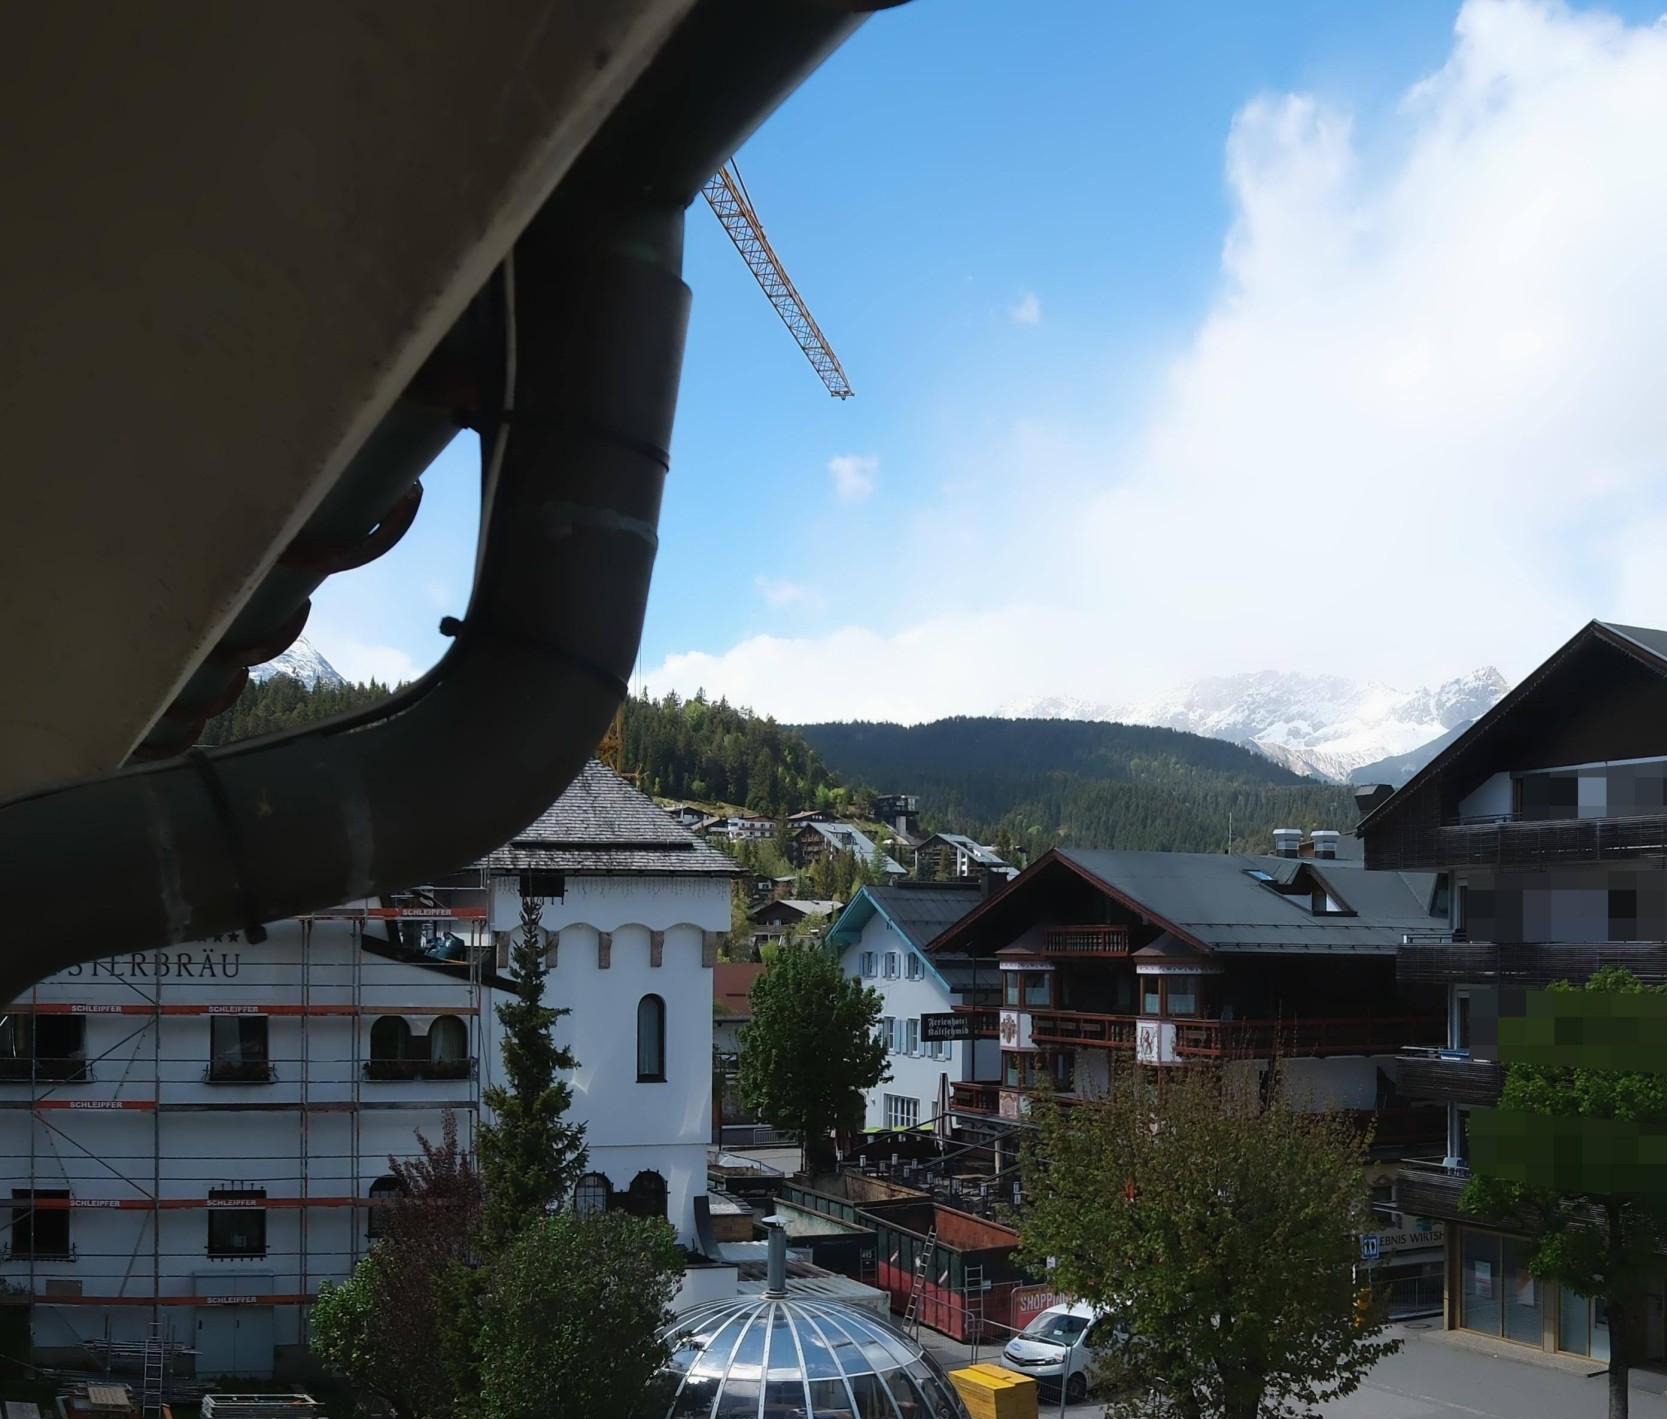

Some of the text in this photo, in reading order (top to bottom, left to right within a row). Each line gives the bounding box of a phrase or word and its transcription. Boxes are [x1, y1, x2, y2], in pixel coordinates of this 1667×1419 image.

[402, 908, 452, 916] SCHLEIPFER
[56, 949, 241, 978] STERBRÄU
[71, 1005, 122, 1013] SCHLEIPFER
[208, 1005, 259, 1014] SCHLEIPFER
[69, 1101, 123, 1109] SCHLEIPFER
